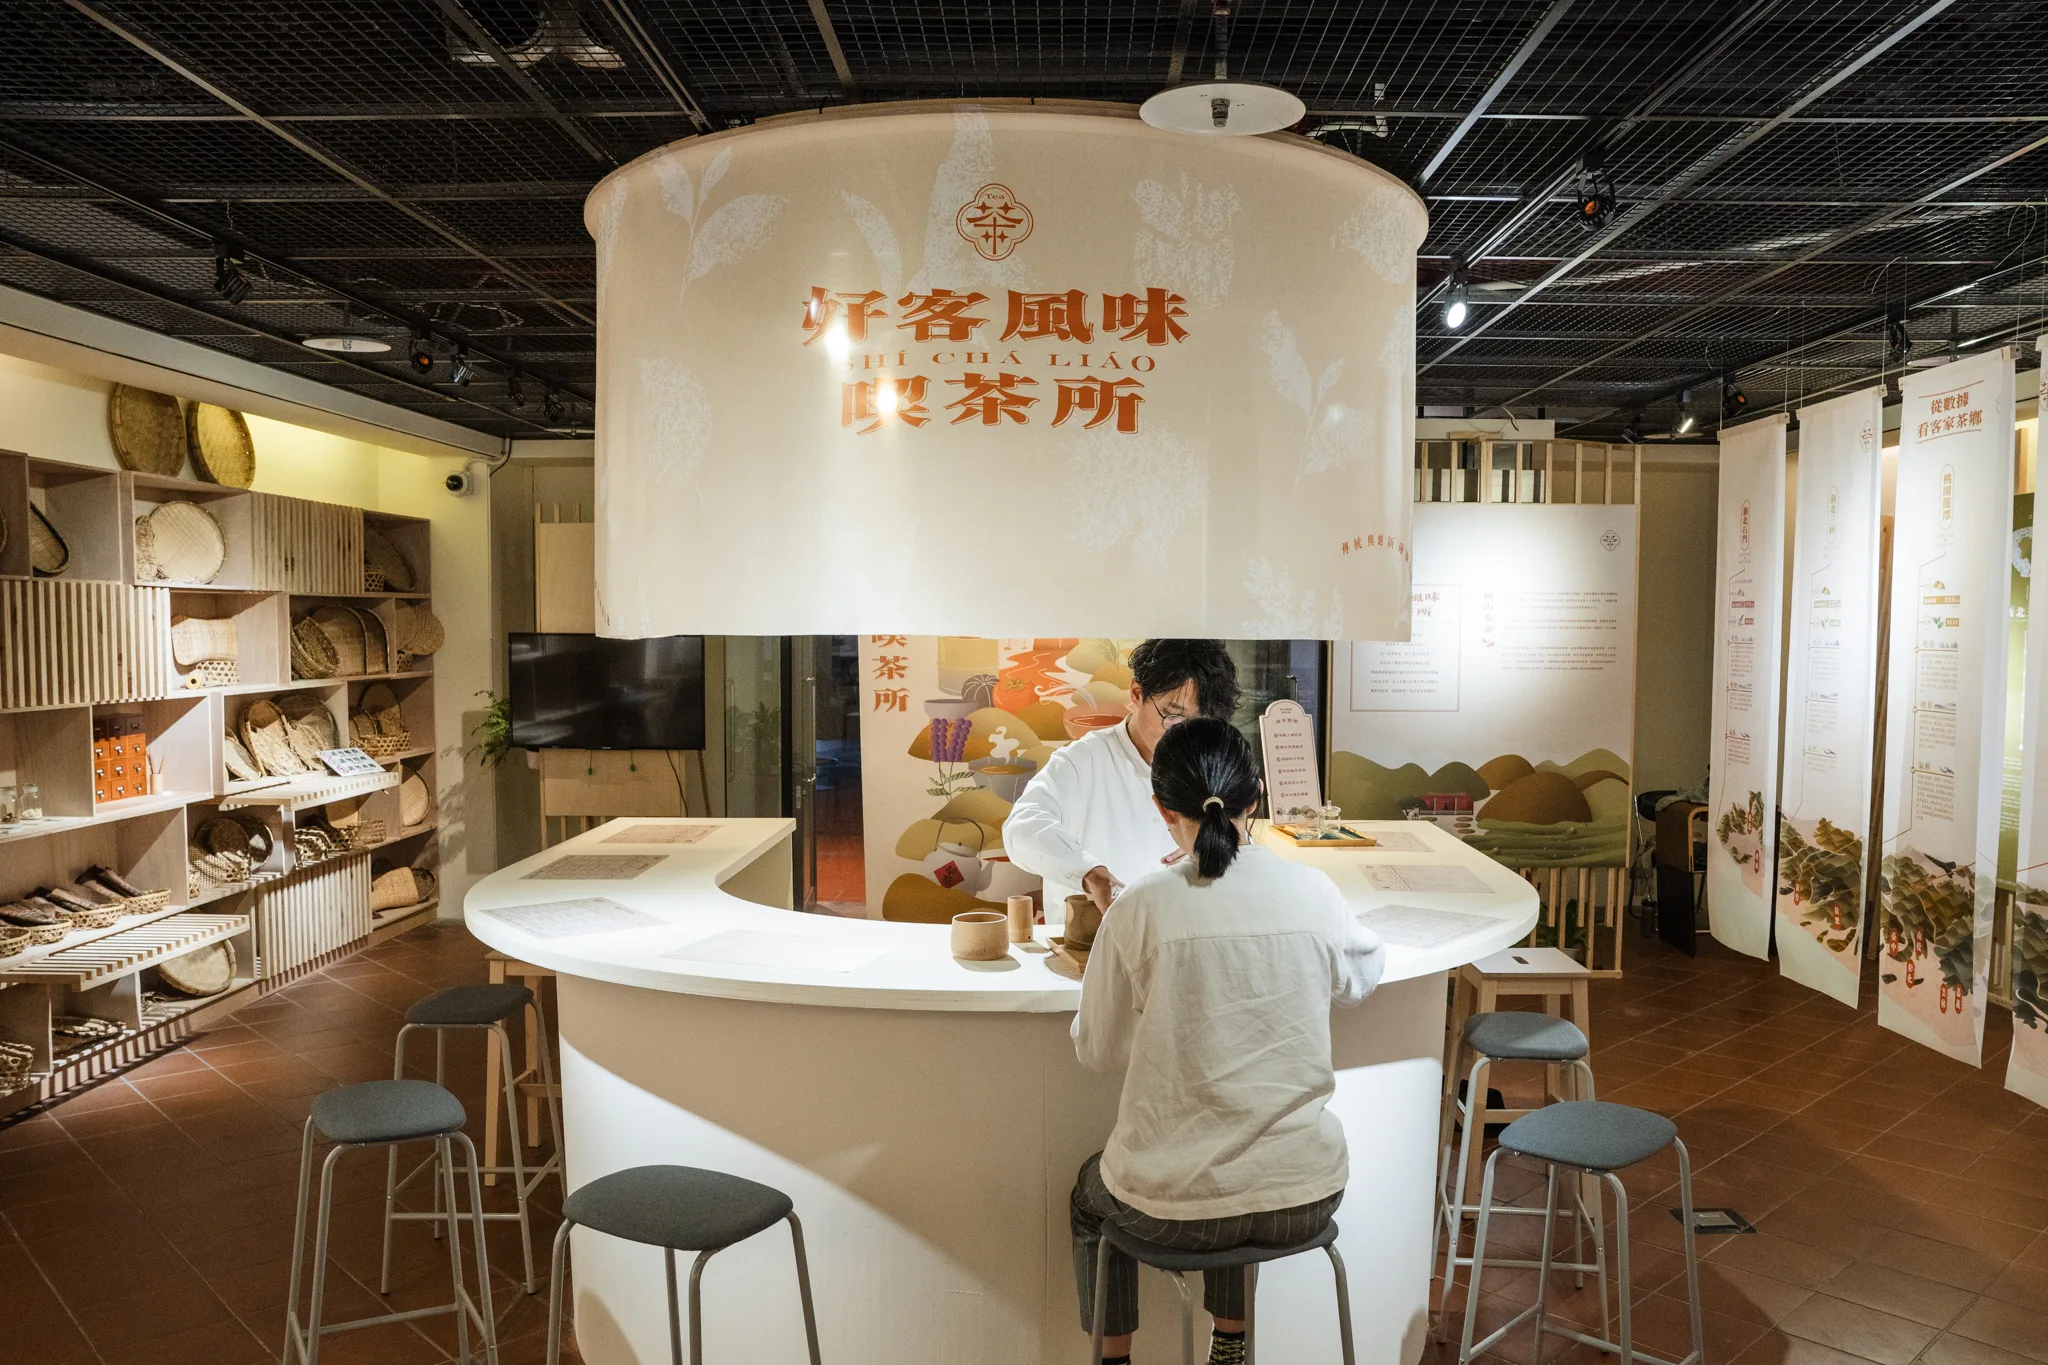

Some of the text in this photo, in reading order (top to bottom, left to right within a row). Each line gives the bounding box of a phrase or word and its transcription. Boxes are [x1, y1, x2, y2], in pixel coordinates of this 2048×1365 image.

[802, 287, 1191, 346] 好客風味
[932, 350, 1022, 364] CHÁ
[1048, 351, 1156, 372] LIÁO
[842, 372, 1146, 435] 喫茶所
[1931, 391, 1969, 415] 從數據
[1916, 409, 1983, 438] 看客家茶鄉
